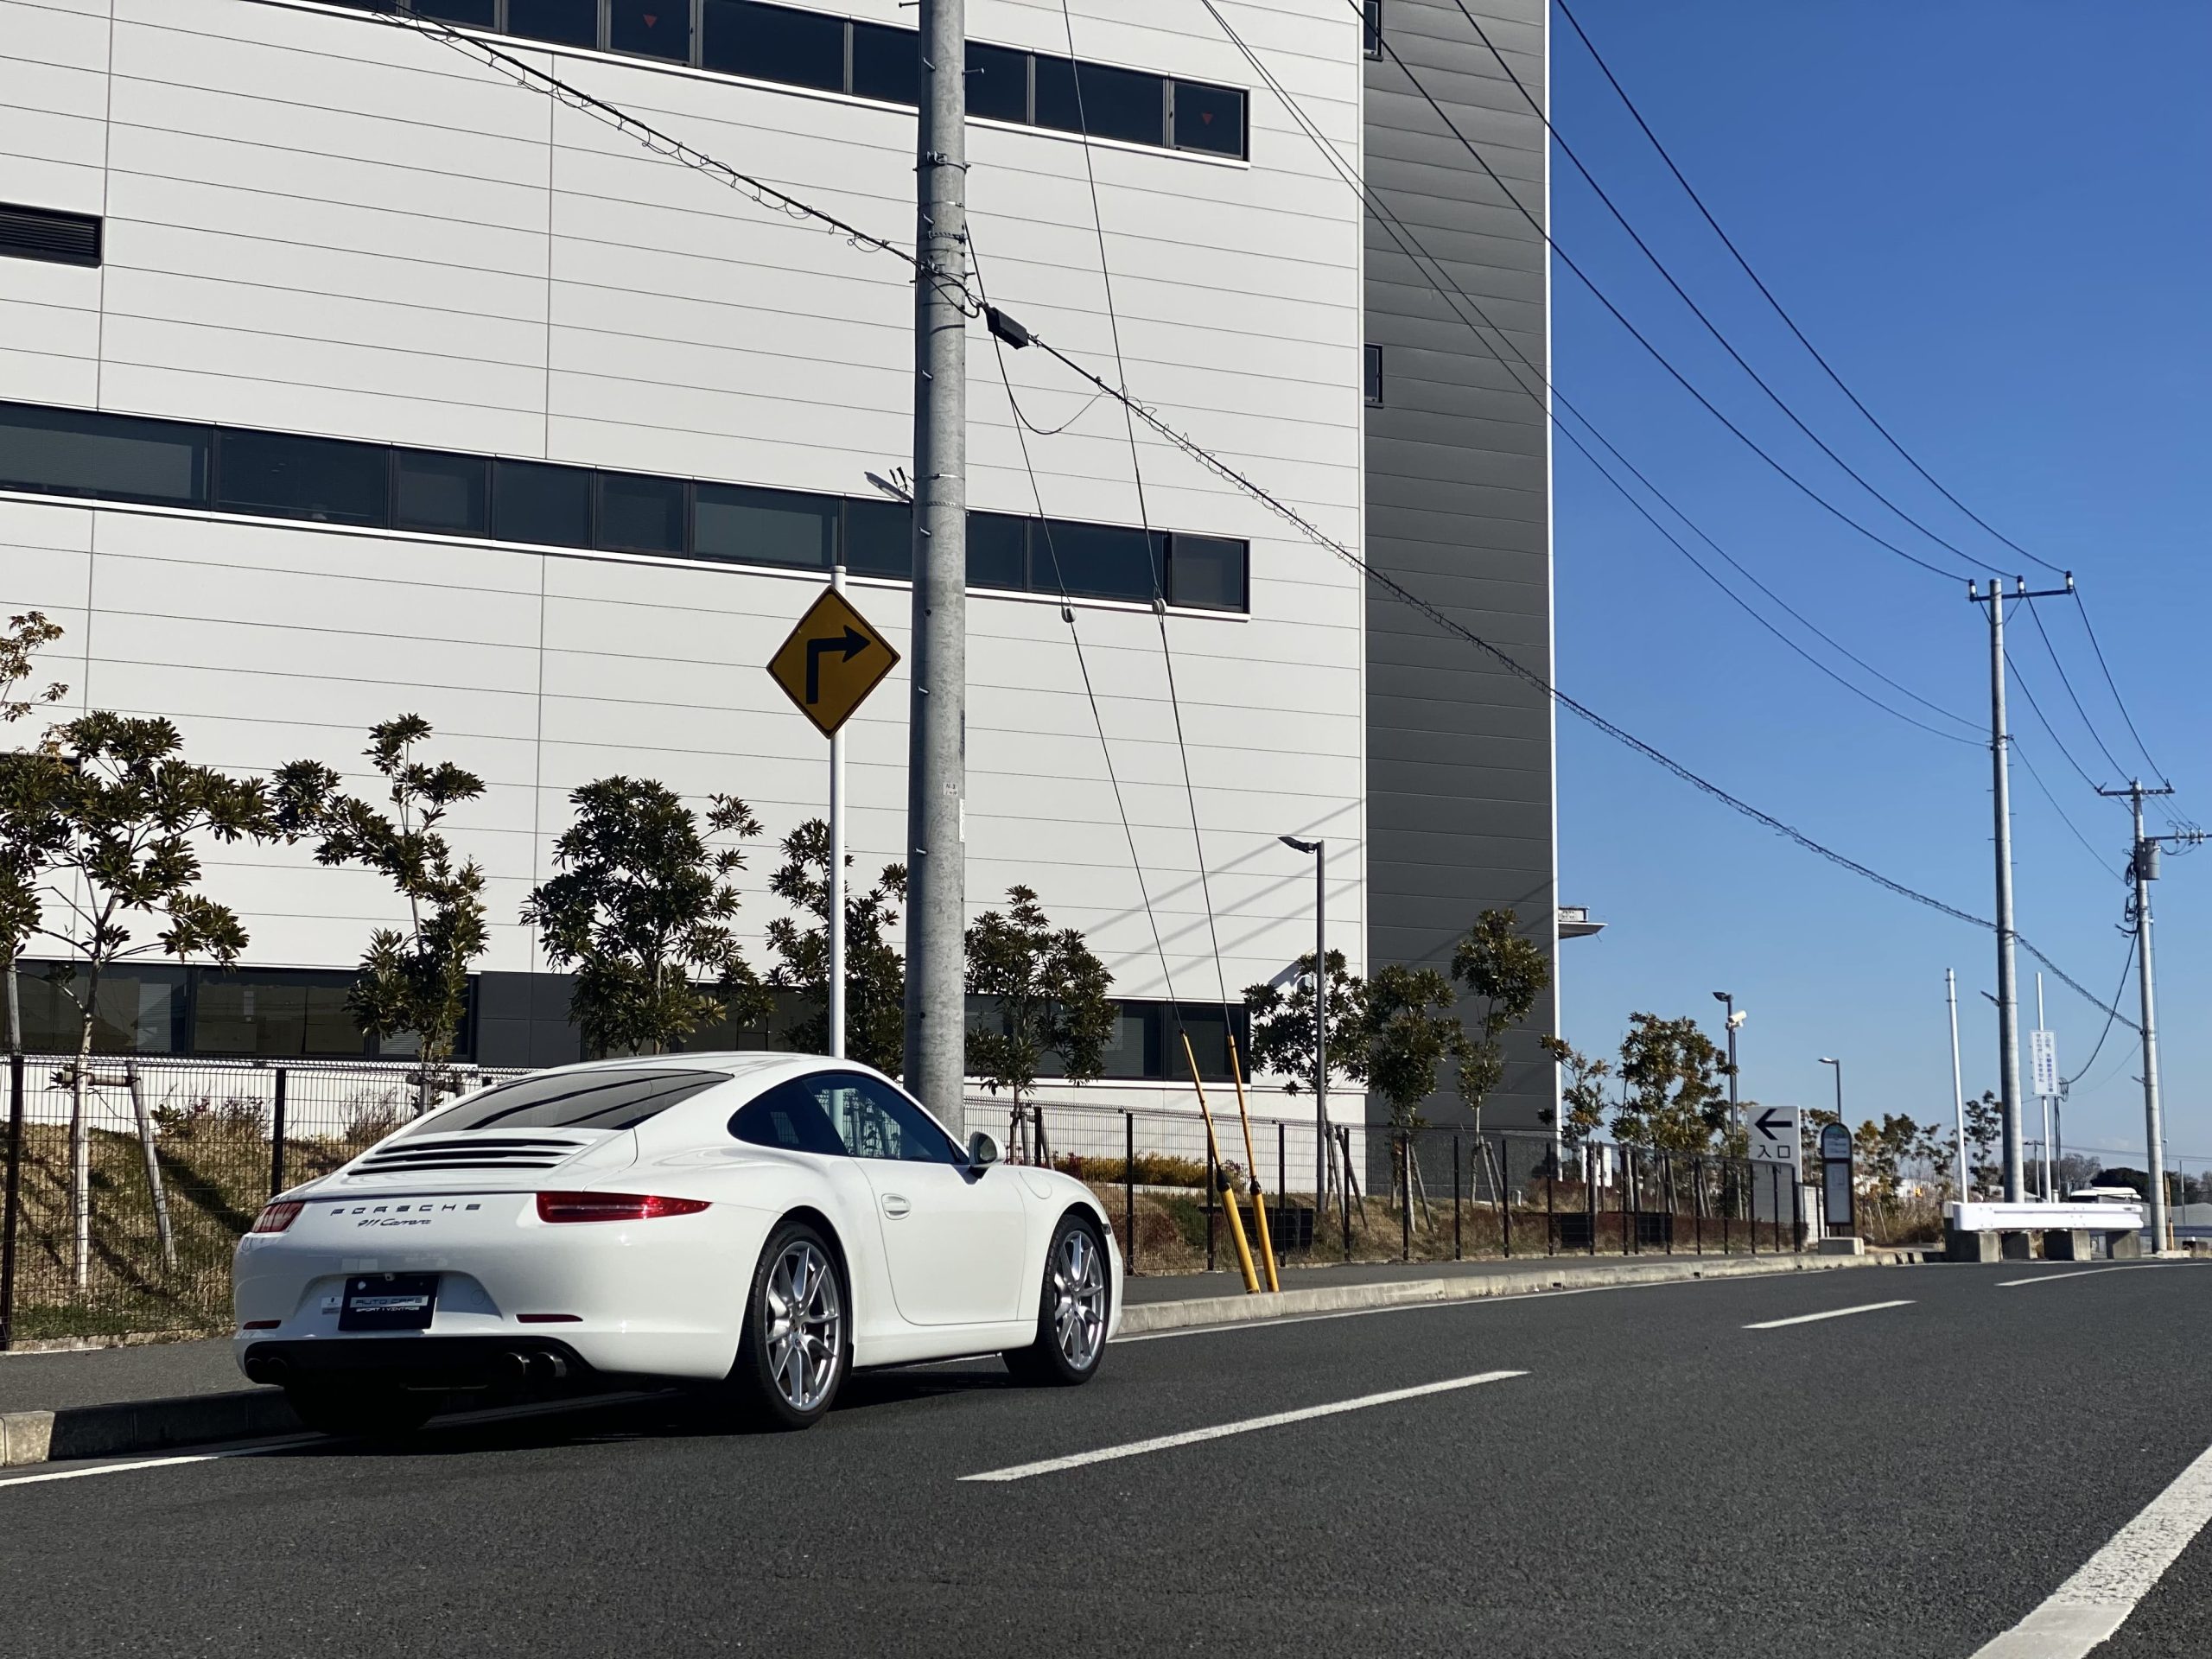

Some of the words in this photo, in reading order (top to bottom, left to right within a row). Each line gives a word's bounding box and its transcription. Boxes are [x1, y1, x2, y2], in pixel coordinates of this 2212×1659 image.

[1758, 1144, 1790, 1159] 入口
[330, 1204, 481, 1217] PORSCHE
[357, 1218, 380, 1227] 911
[380, 1217, 431, 1227] Carrera
